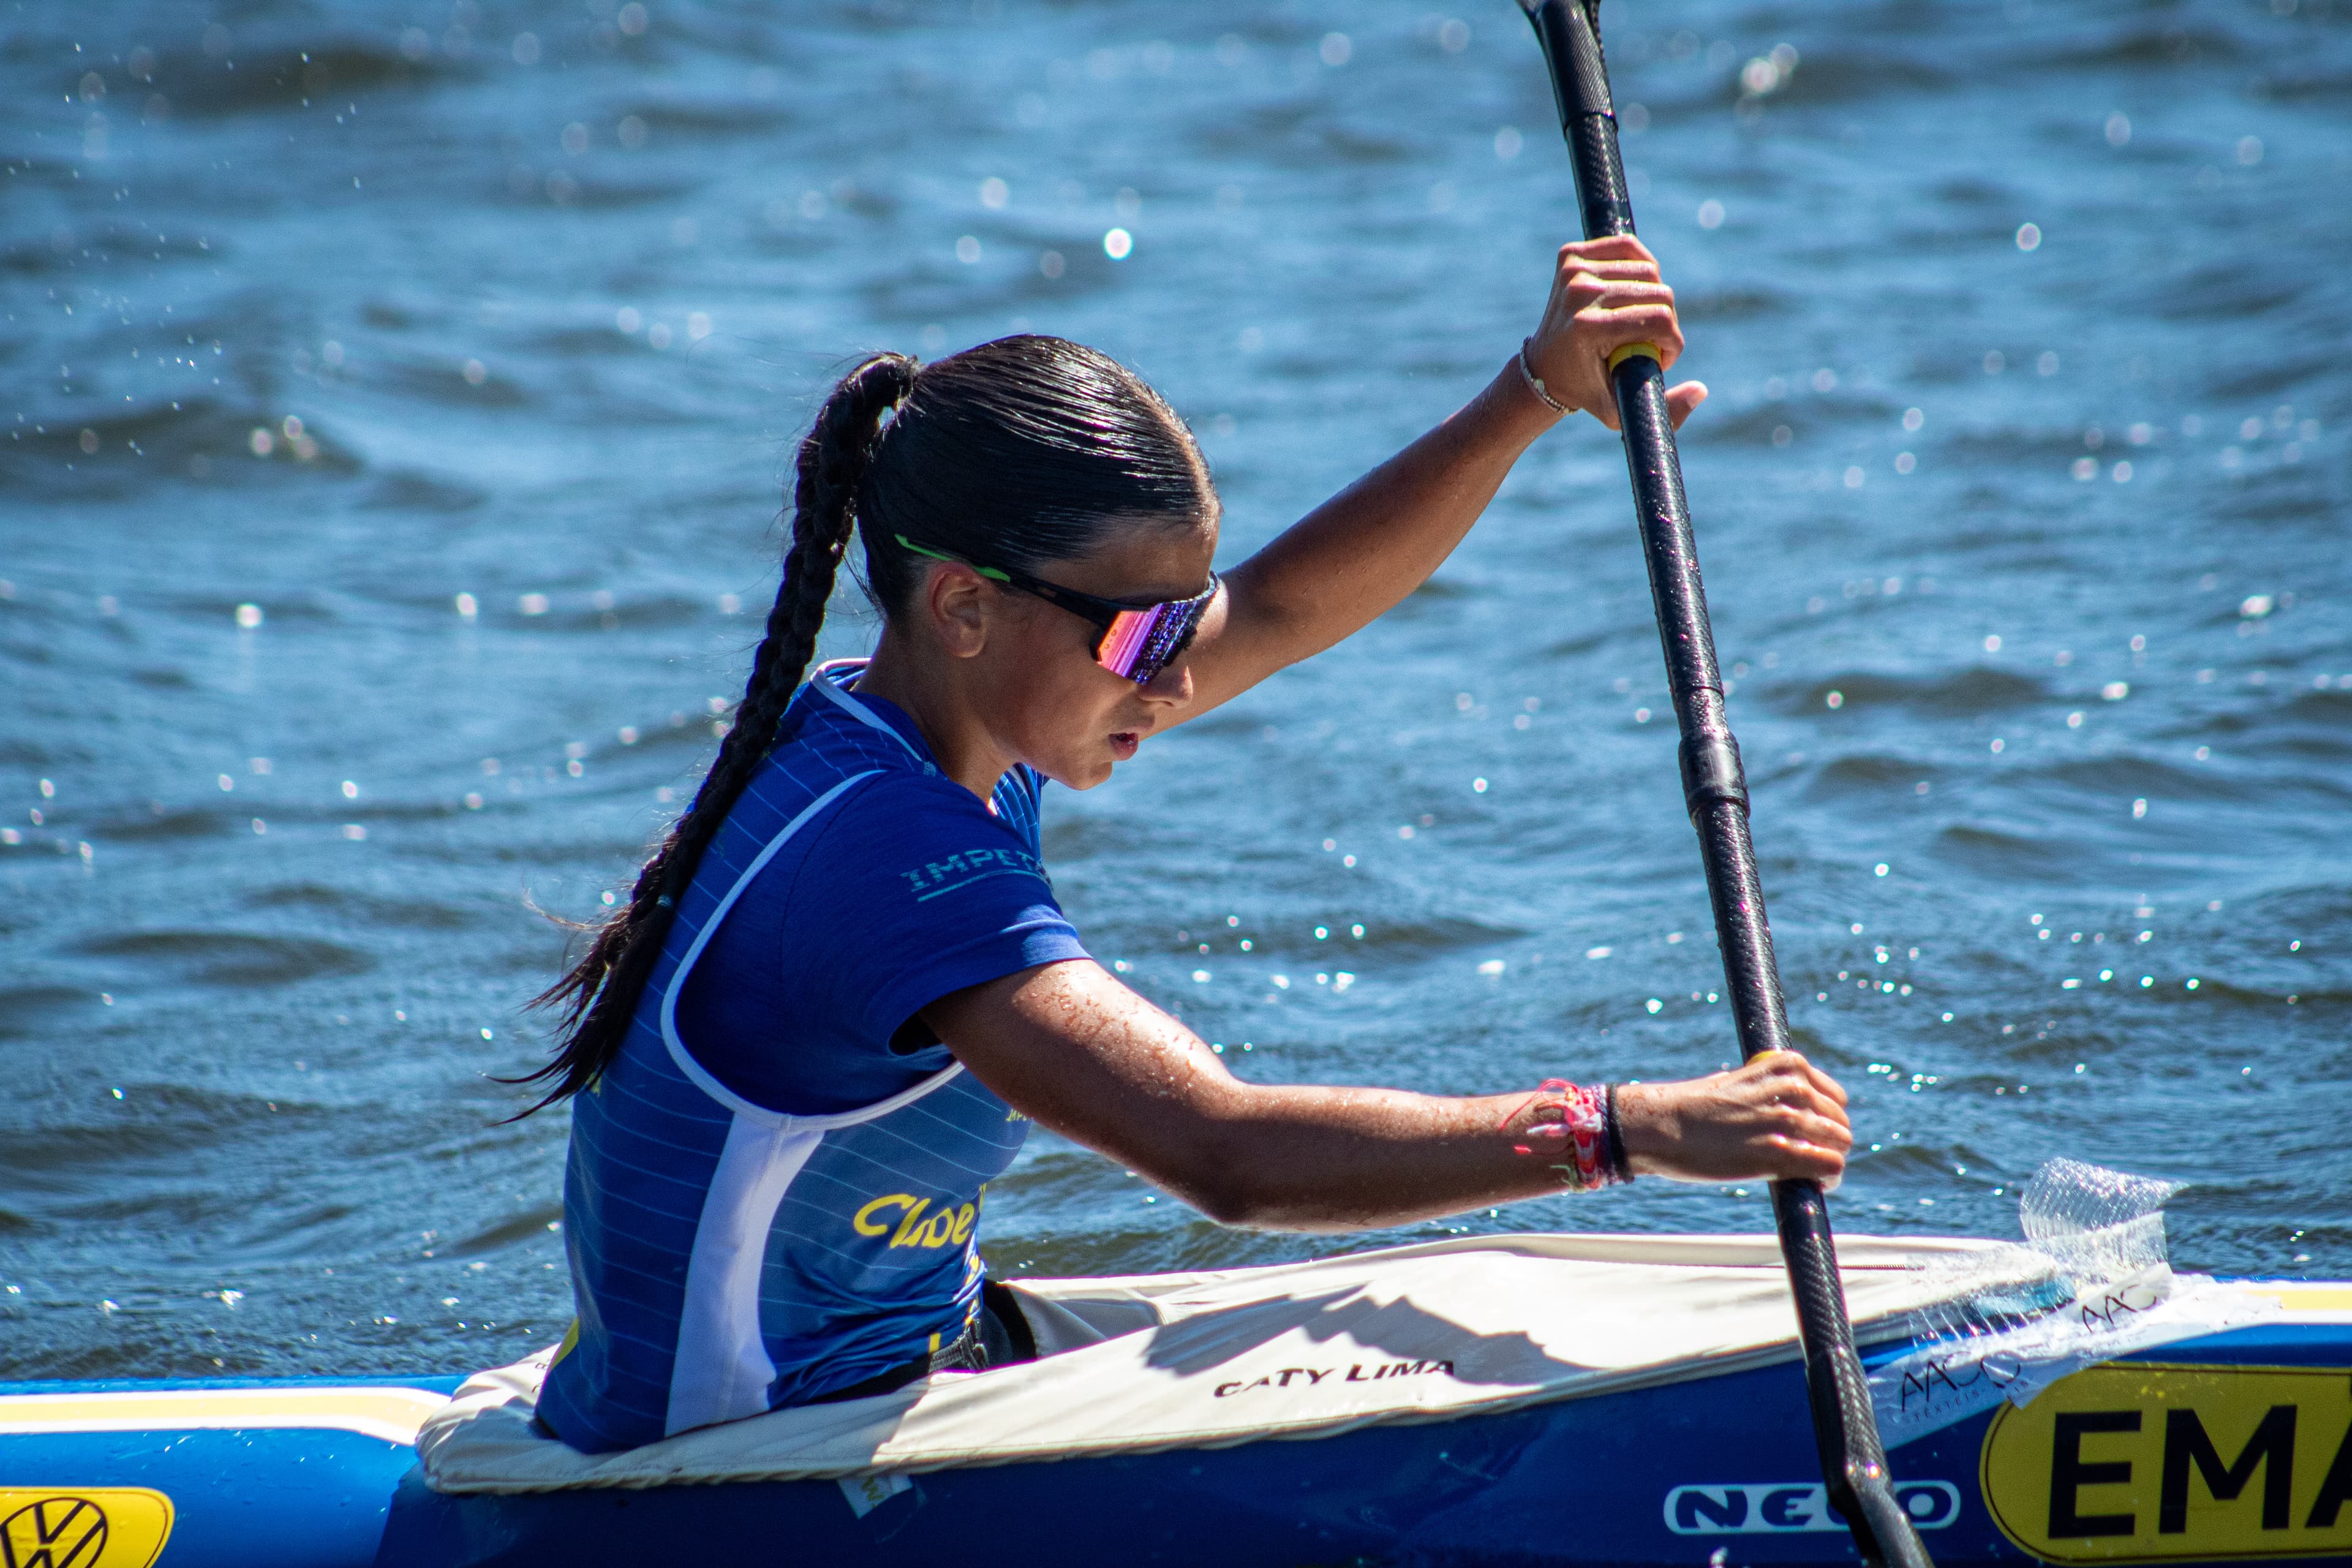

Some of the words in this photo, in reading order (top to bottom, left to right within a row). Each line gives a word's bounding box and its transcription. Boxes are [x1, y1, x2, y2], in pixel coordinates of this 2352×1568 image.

[1213, 1368, 1337, 1398] CATY
[1345, 1360, 1455, 1382] LIMA
[1674, 1485, 1954, 1531] NEO
